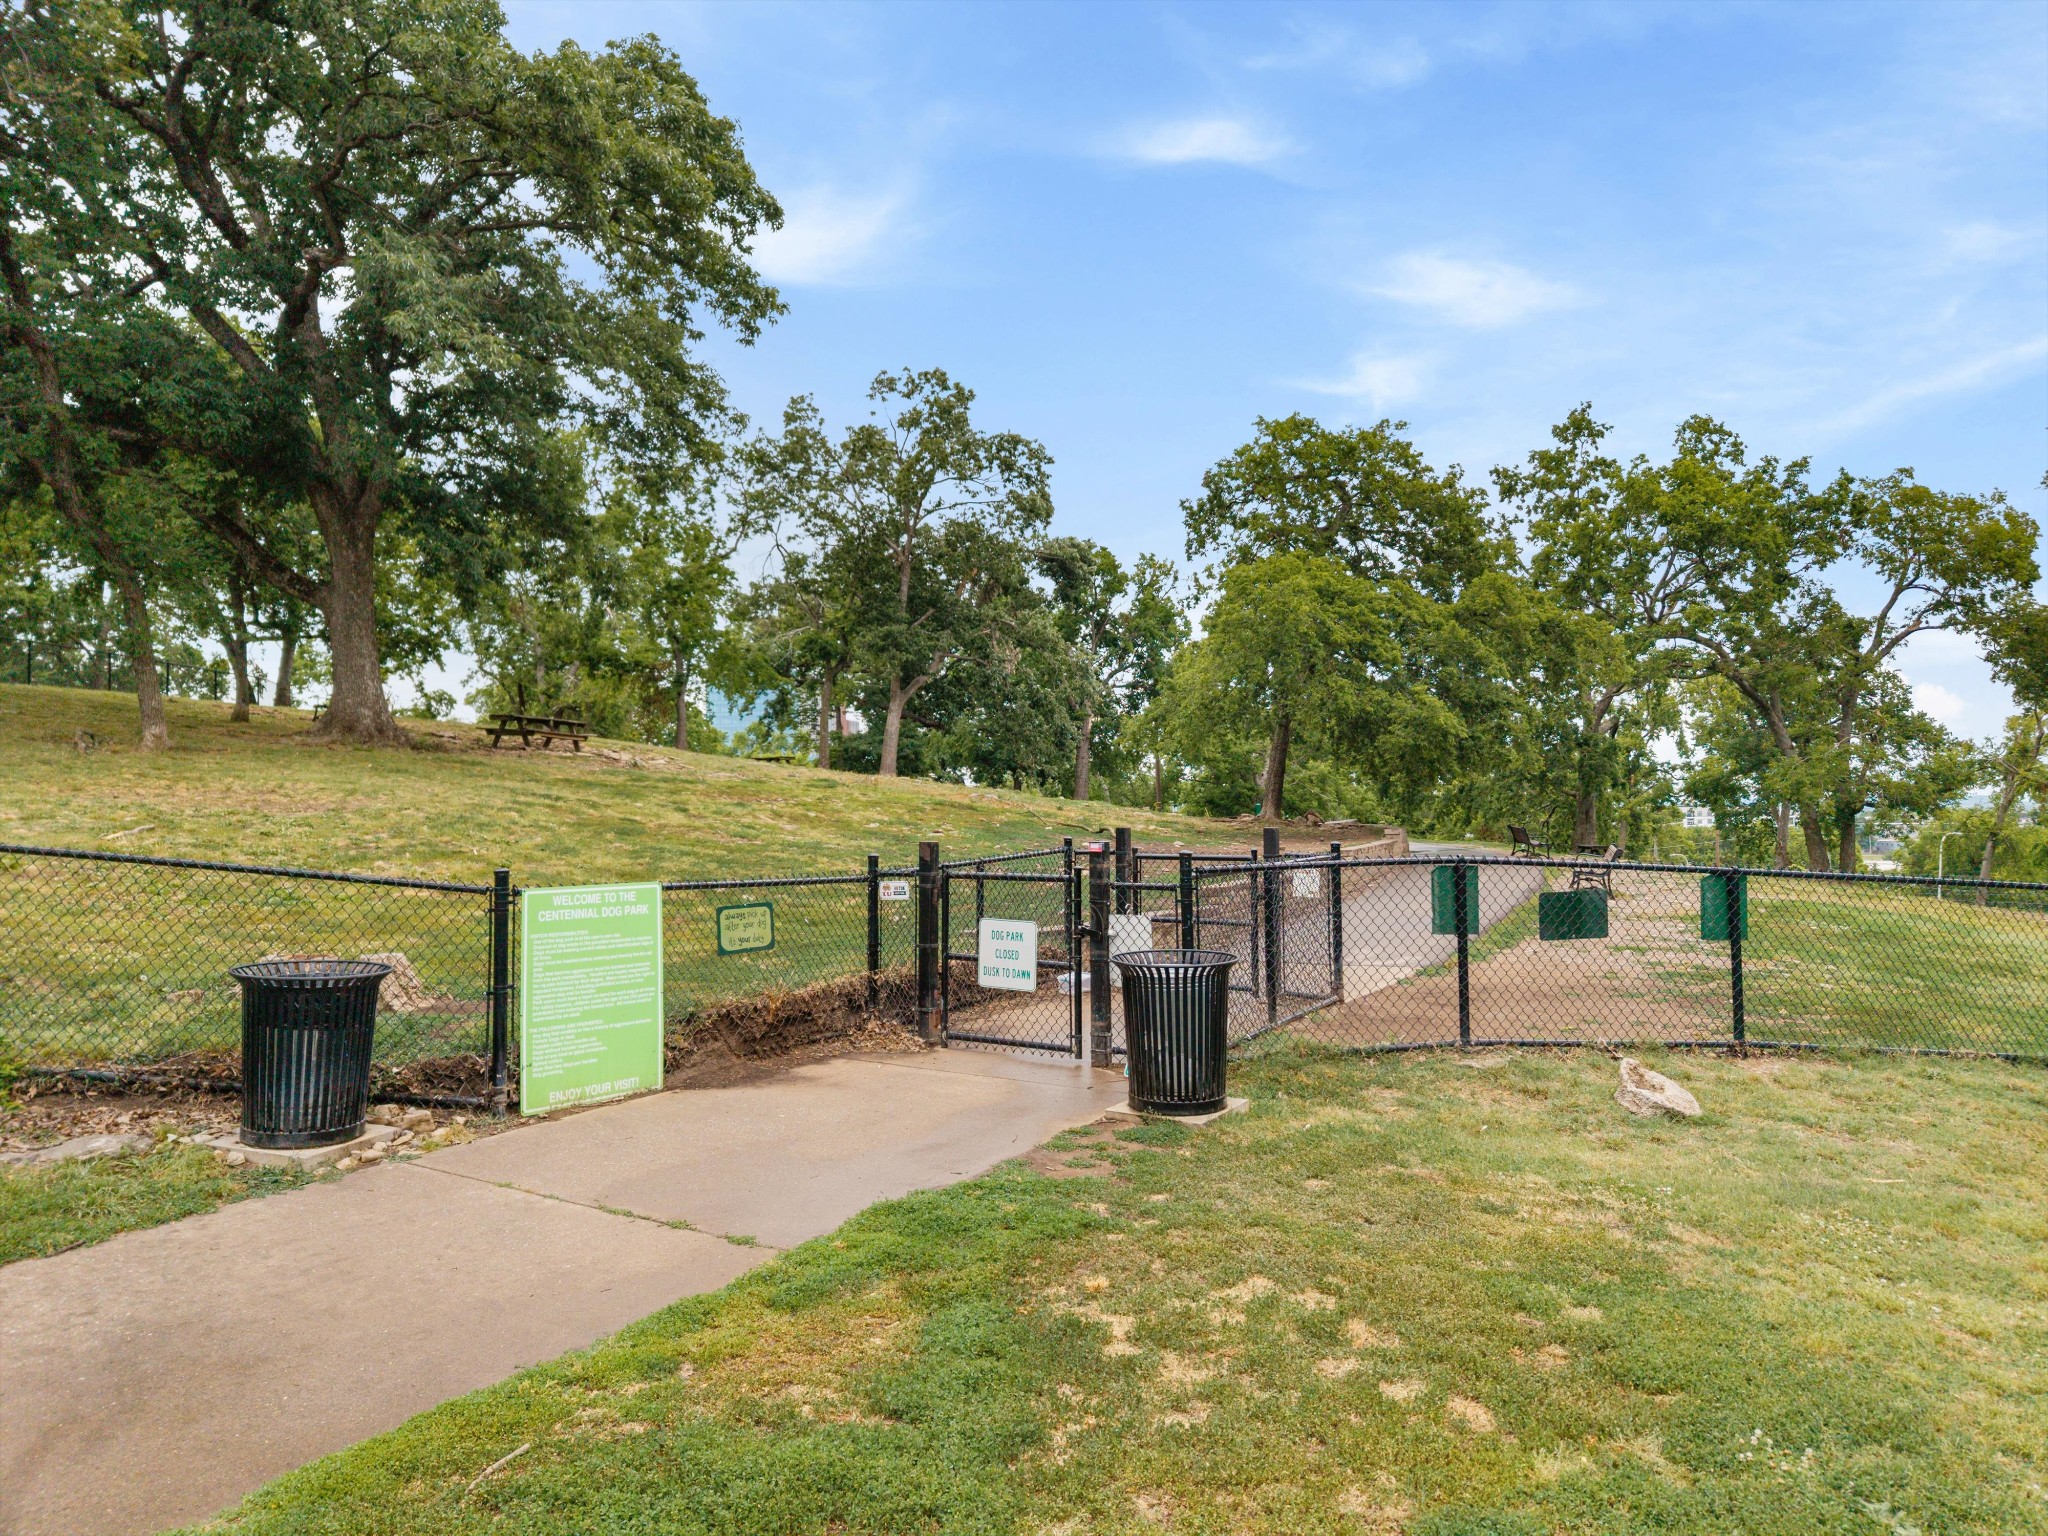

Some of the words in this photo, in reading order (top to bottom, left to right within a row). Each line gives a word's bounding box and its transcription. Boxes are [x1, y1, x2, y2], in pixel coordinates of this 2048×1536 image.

[553, 893, 601, 906] WELCOME
[604, 892, 616, 903] TO
[619, 891, 637, 902] THE
[538, 908, 599, 922] CENTENNIAL
[602, 906, 622, 917] DOG
[624, 904, 649, 915] PARK
[725, 912, 746, 921] always
[725, 921, 739, 931] after
[743, 922, 754, 932] your
[738, 936, 751, 946] your
[991, 930, 1004, 940] DOG
[1006, 931, 1024, 942] PARK
[995, 949, 1020, 960] CLOSED
[983, 966, 1000, 977] DUSK
[1002, 968, 1010, 978] TO
[1012, 969, 1031, 980] DAWN
[549, 1088, 583, 1103] ENJOY
[585, 1082, 611, 1096] YOUR
[614, 1077, 640, 1090] VISIT!
